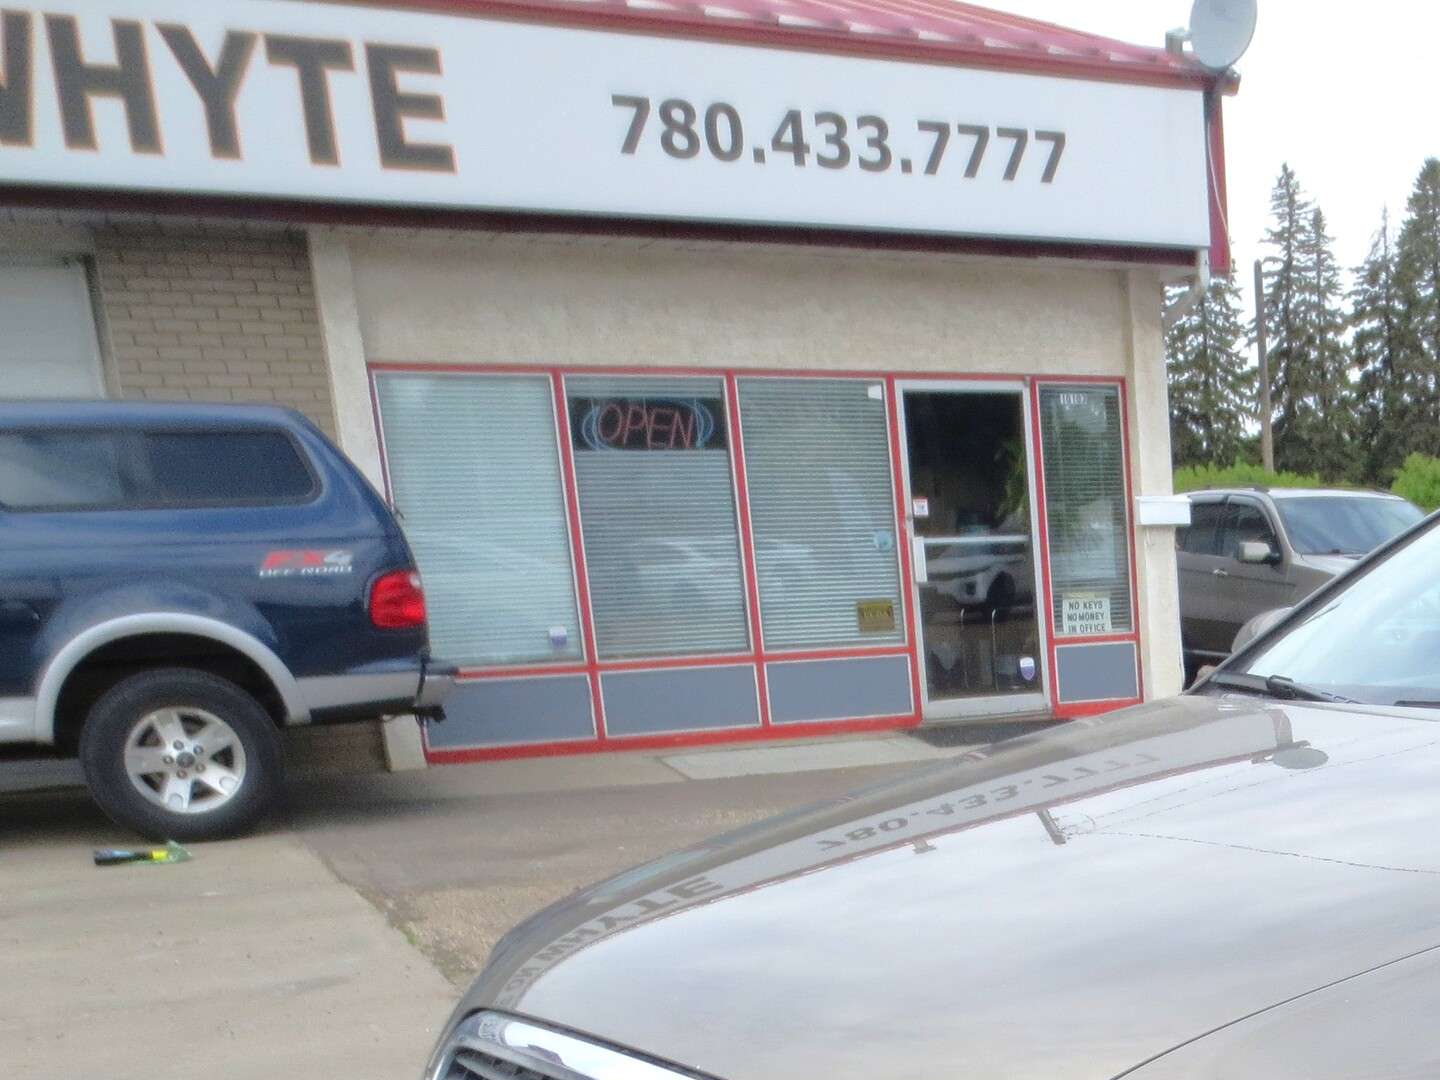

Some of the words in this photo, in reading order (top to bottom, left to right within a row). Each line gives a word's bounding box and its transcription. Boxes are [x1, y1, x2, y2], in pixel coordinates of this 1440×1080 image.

[611, 94, 1066, 184] 780.433.7777
[598, 403, 693, 449] OPEN
[1068, 601, 1080, 610] NO
[1083, 600, 1104, 610] KEYS
[1067, 612, 1078, 622] NO
[1079, 612, 1105, 621] MONEY
[1068, 624, 1078, 633] IN
[1080, 623, 1106, 633] OFFICE
